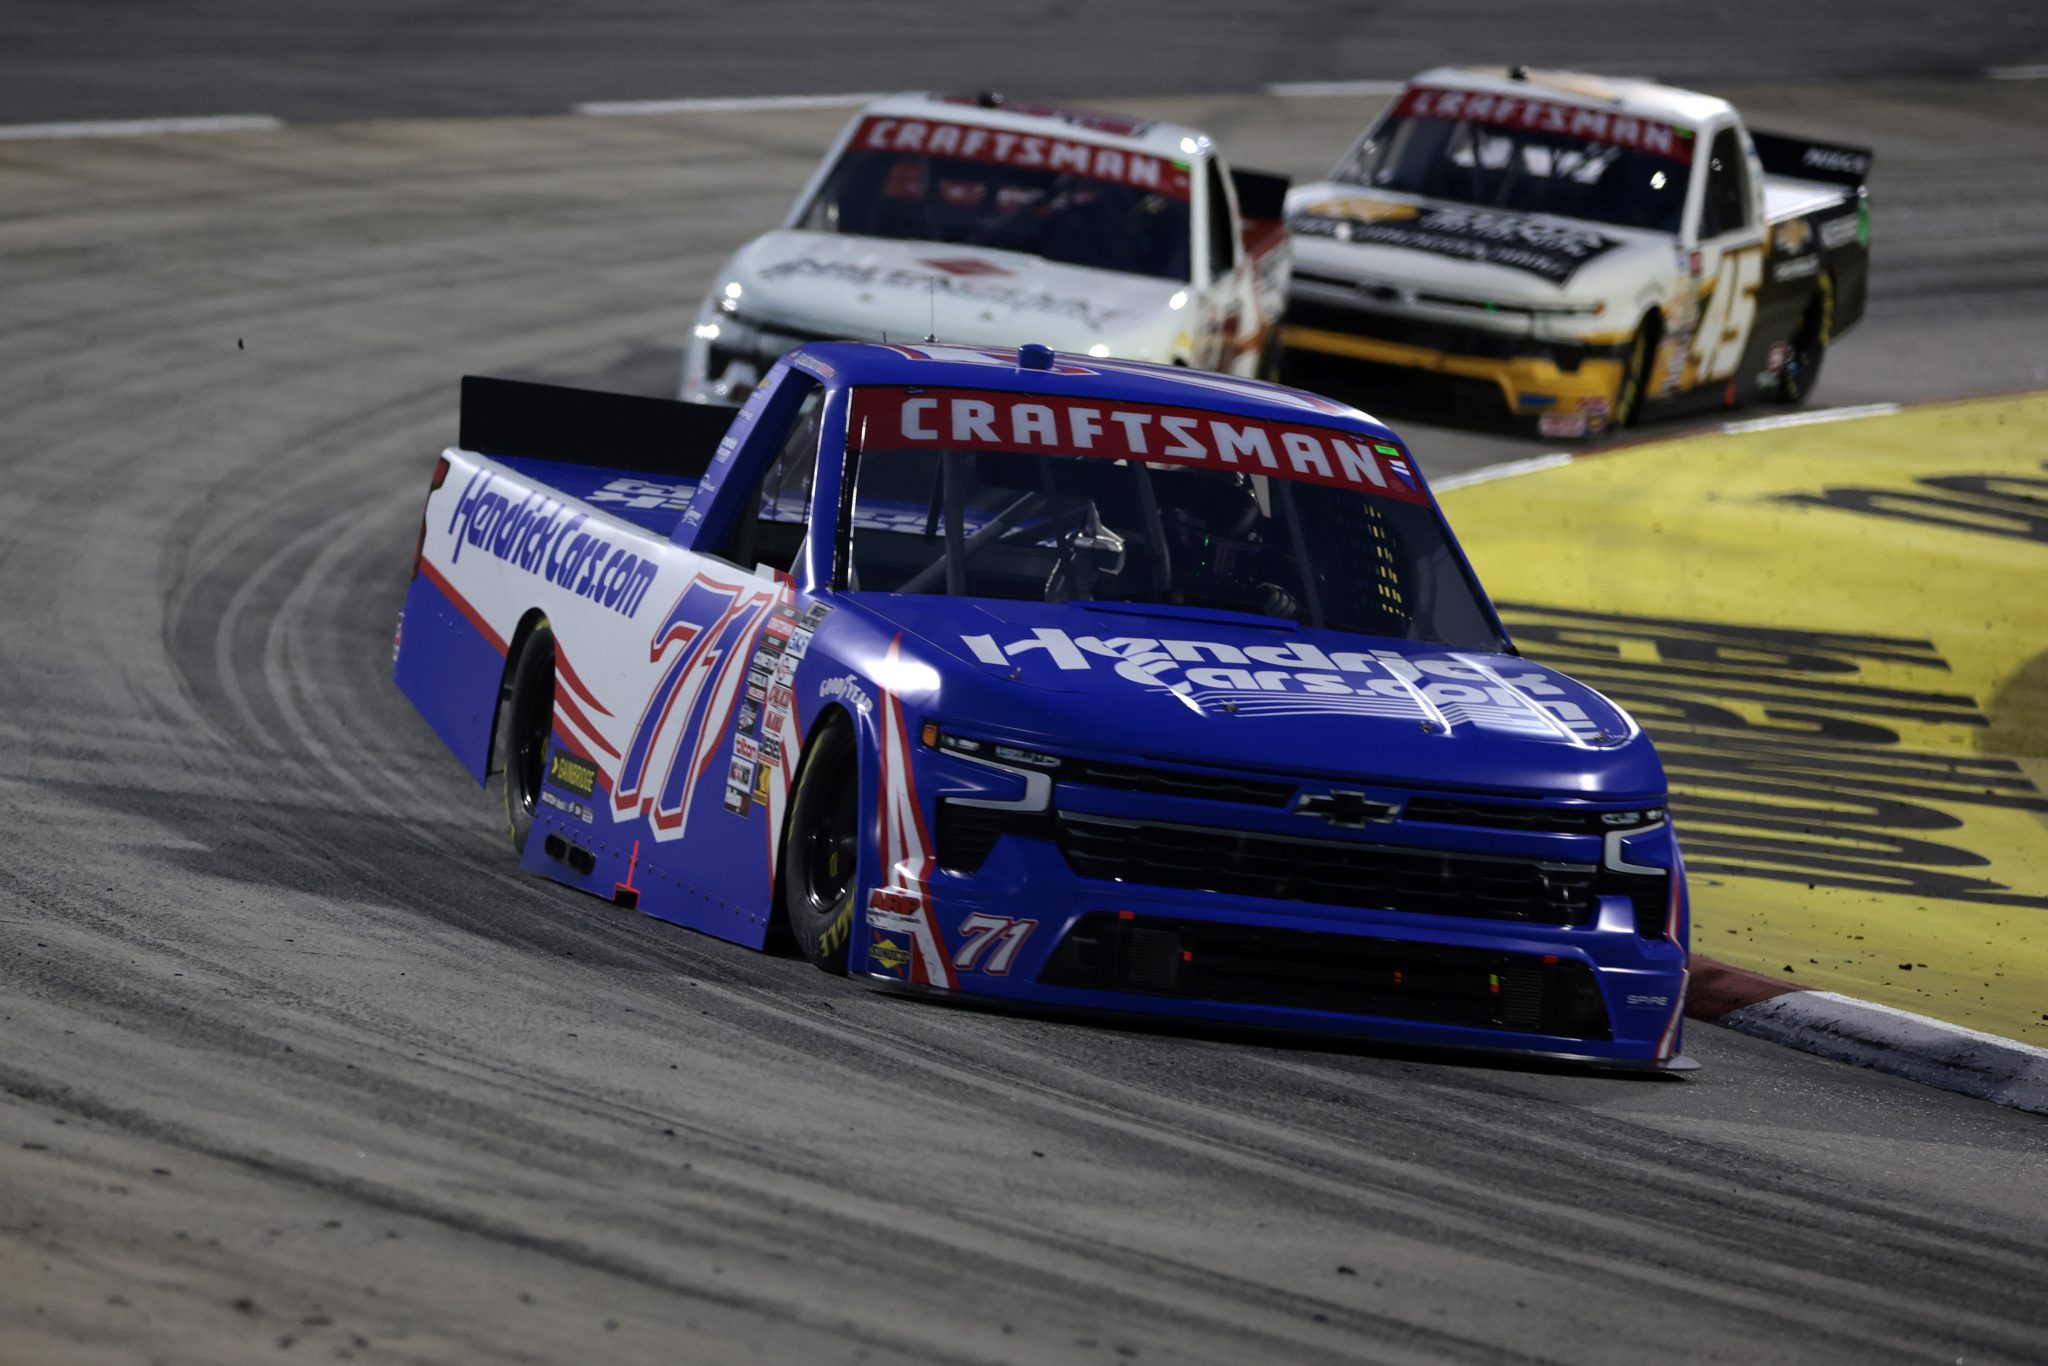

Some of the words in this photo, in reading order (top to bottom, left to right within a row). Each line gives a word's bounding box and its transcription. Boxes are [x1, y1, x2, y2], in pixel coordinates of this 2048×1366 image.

[866, 119, 1162, 186] CRAFTSMAN
[1412, 90, 1674, 153] CRAFTSMAN
[901, 398, 1388, 489] CRAFTSMAN
[448, 467, 658, 619] HendrickCars.com
[959, 627, 1567, 698] Hendrick
[1114, 657, 1599, 729] Cars.com
[610, 571, 774, 843] 71
[953, 911, 1040, 977] 71
